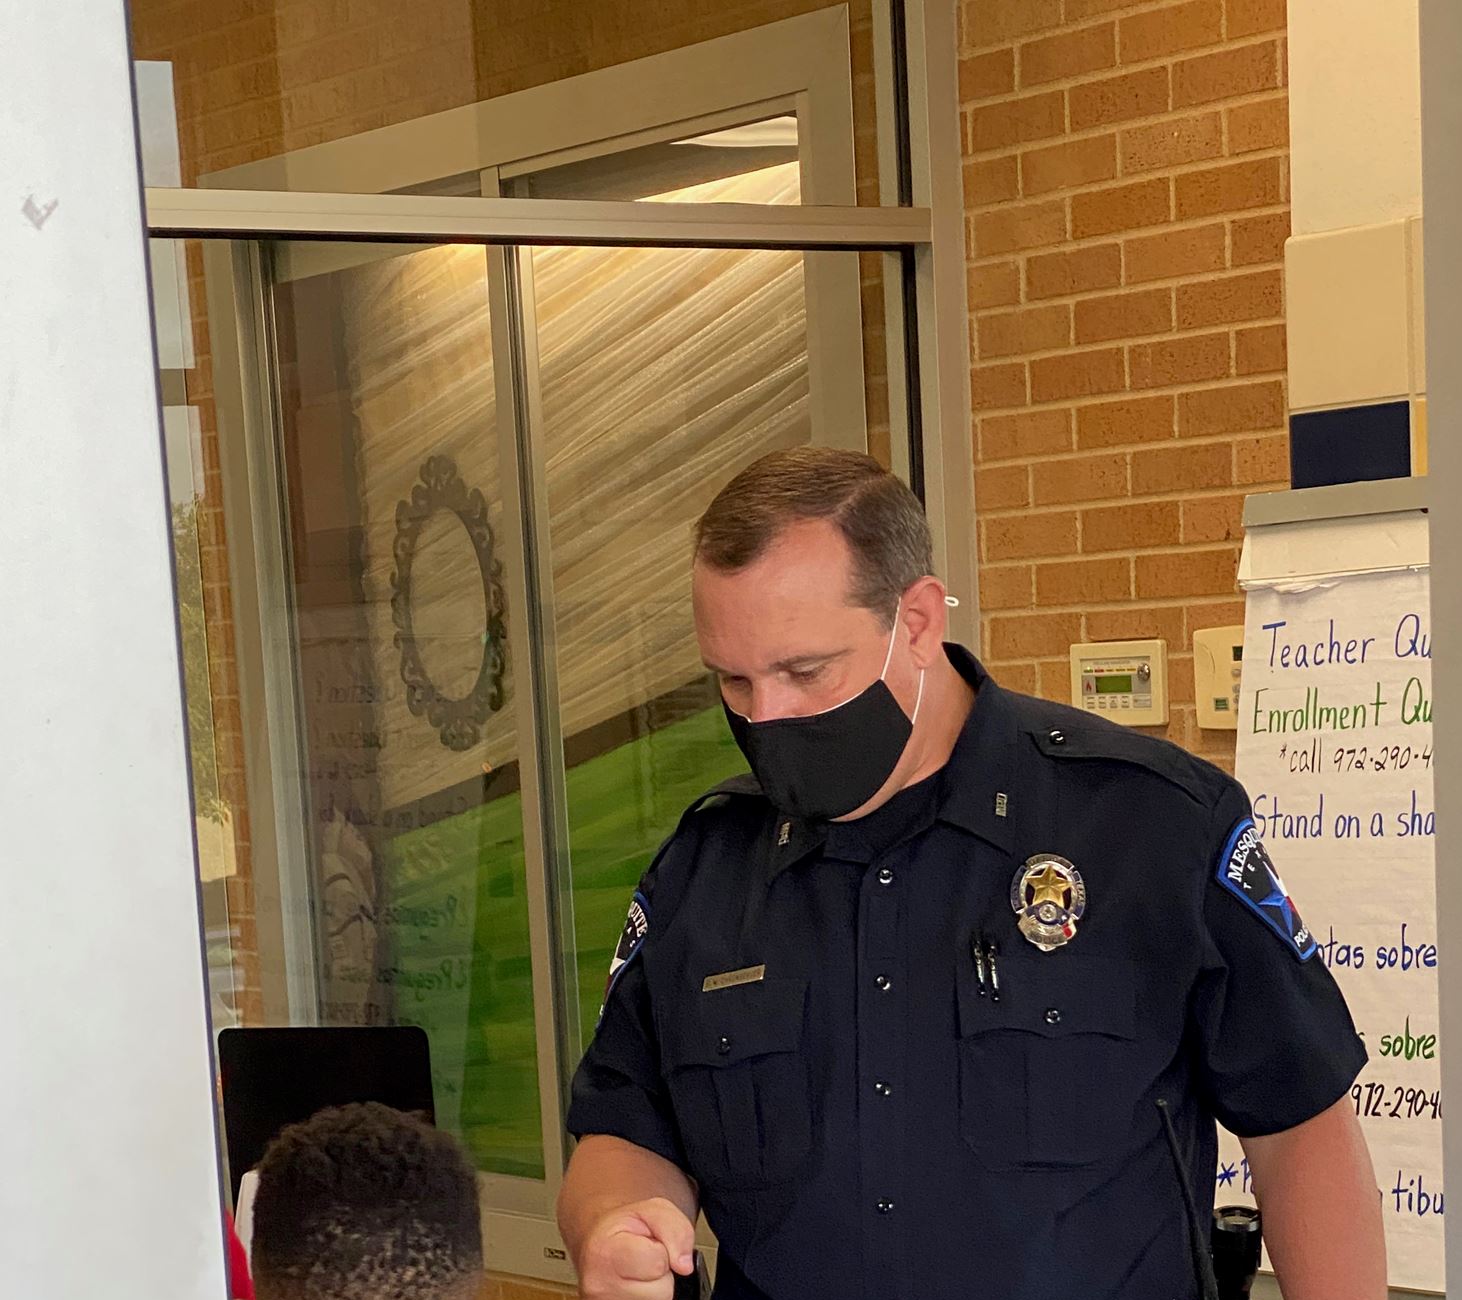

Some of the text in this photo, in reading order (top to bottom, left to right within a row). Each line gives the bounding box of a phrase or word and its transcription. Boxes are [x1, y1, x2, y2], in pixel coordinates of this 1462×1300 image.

[1262, 619, 1375, 669] Teacher
[1253, 681, 1388, 734] Enrollment
[1253, 789, 1436, 840] Stand on a sha
[627, 901, 649, 938] UITE
[1375, 923, 1438, 972] sobre
[1378, 1014, 1437, 1062] sobre
[1350, 1082, 1443, 1120] 972-290-4
